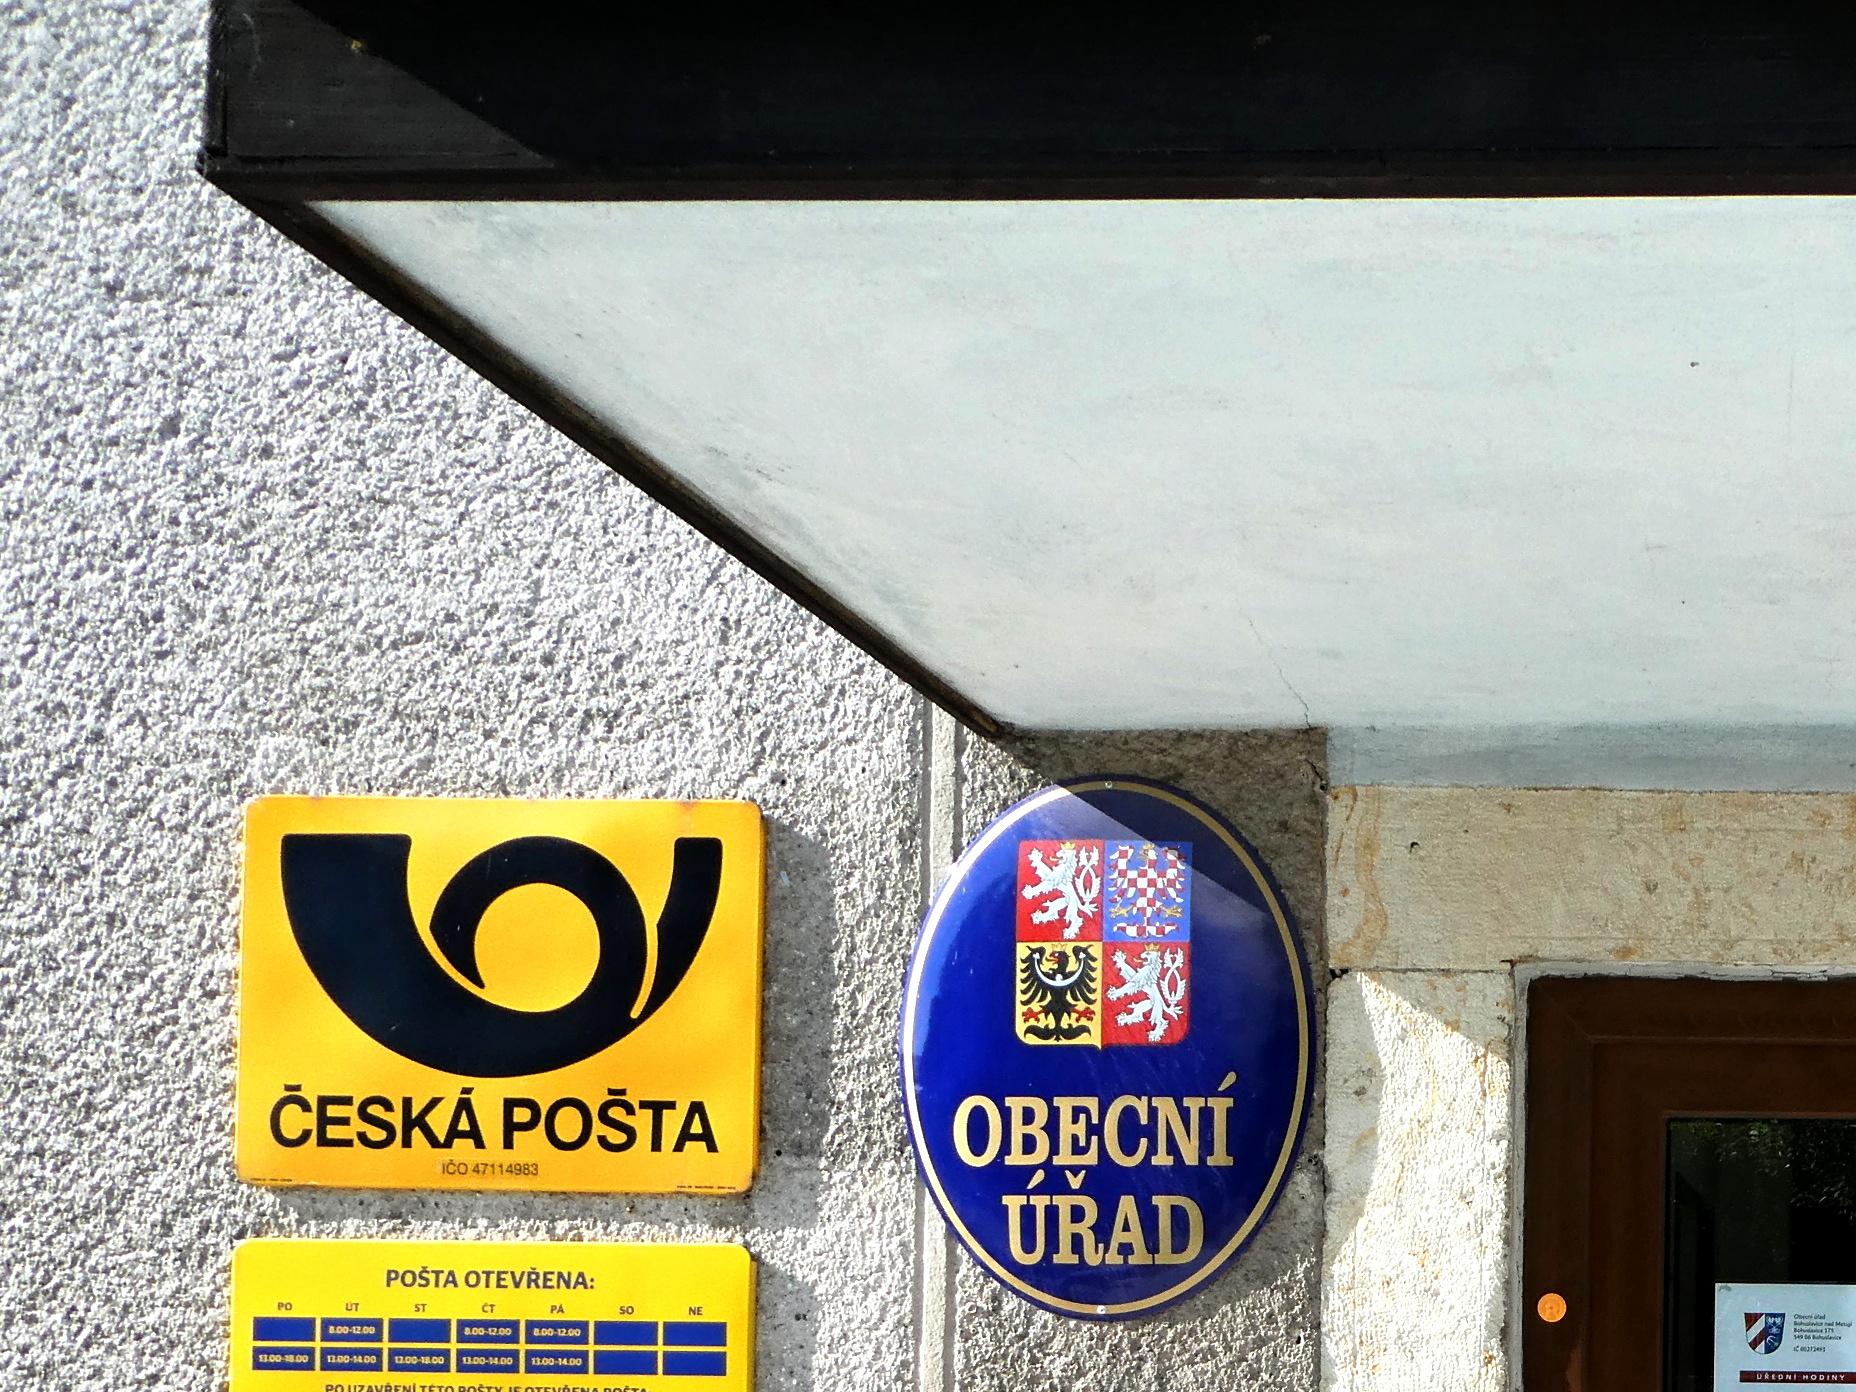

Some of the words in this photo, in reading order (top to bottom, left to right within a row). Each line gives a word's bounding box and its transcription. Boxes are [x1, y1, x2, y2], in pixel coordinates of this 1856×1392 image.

[269, 1083, 486, 1150] ČESKÁ
[502, 1088, 719, 1153] POŠTA
[953, 1071, 1237, 1167] OBECNÍ
[442, 1160, 468, 1175] IČO
[472, 1162, 539, 1176] 47114983
[1002, 1169, 1204, 1266] ÚŘAD
[386, 1267, 459, 1288] POŠTA
[464, 1268, 595, 1290] OTEVŘENA:
[277, 1302, 293, 1311] PO
[414, 1303, 427, 1313] ST
[481, 1302, 496, 1313] ČT
[550, 1303, 564, 1314] PÁ
[619, 1306, 634, 1315] SO
[689, 1306, 703, 1315] NE
[1756, 1371, 1797, 1380] ÚŘEDNÍ
[1802, 1373, 1845, 1381] HODINY
